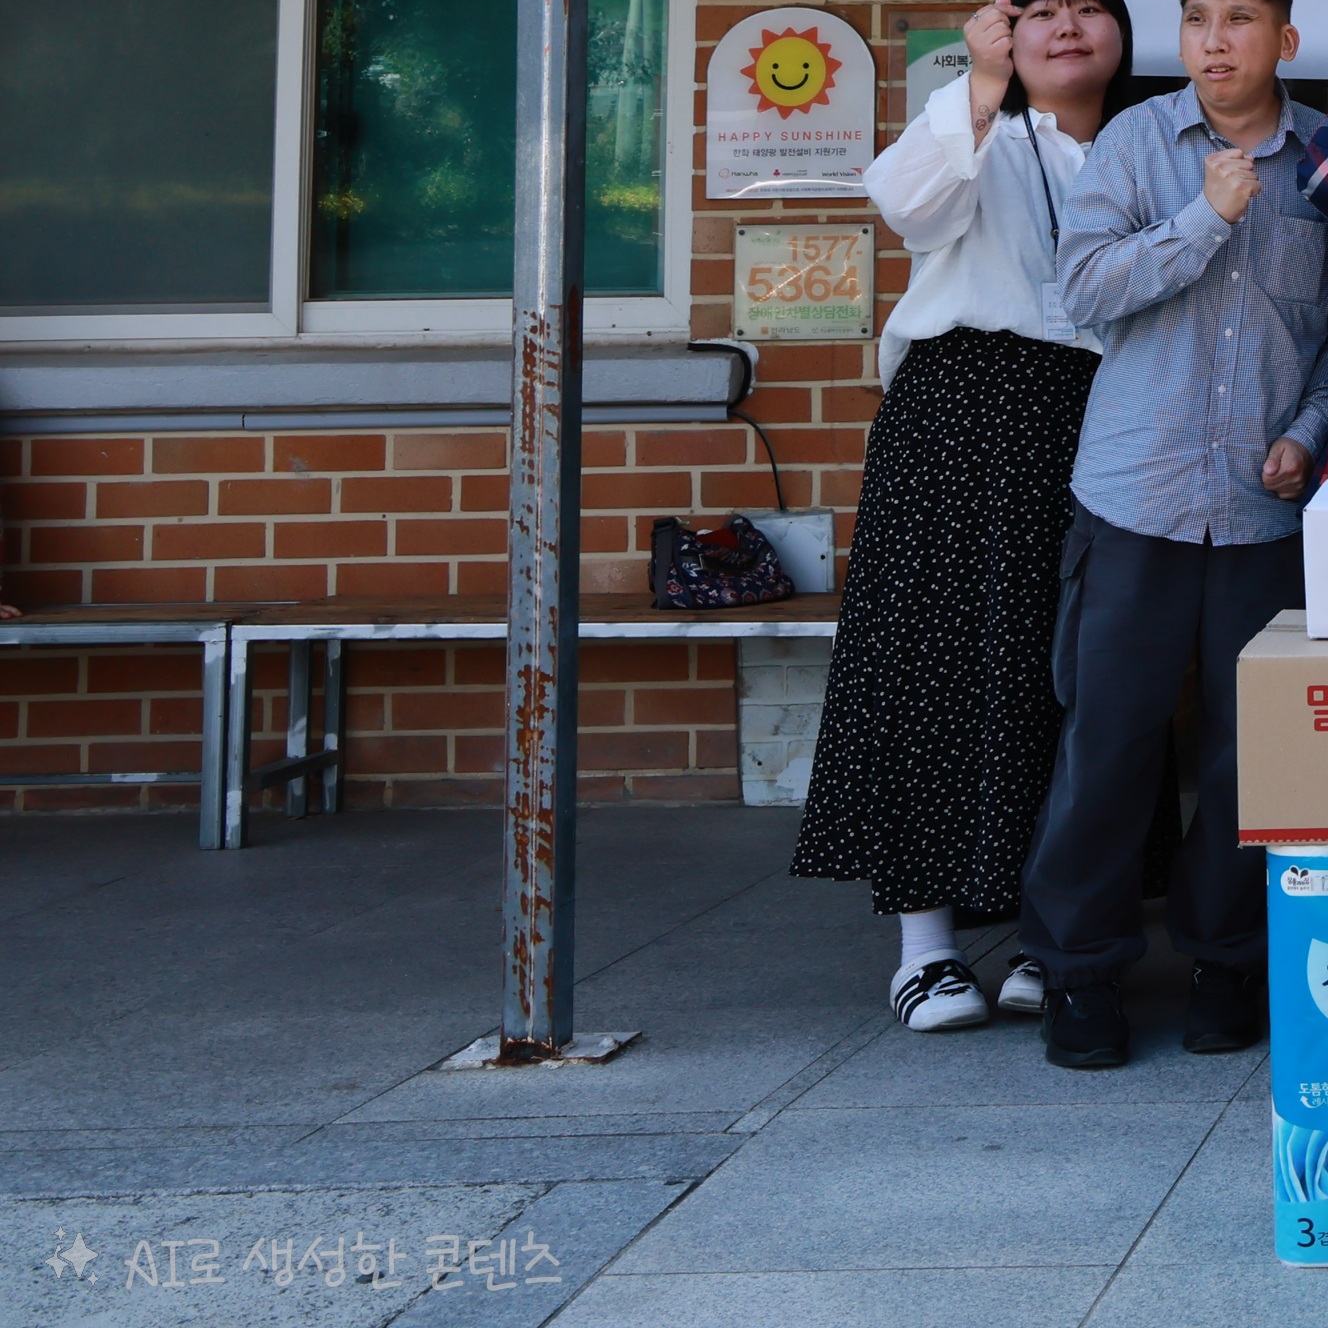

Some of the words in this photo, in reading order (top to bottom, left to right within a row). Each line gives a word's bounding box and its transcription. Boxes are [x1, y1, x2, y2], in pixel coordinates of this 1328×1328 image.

[933, 54, 973, 68] 사회복
[718, 131, 773, 142] HAPPY
[781, 130, 863, 141] SUNSHINE
[733, 148, 750, 158] 한화
[752, 148, 777, 158] 태양광
[780, 147, 812, 157] 발전설비
[815, 147, 847, 157] 지원기관
[747, 265, 861, 303] 5364
